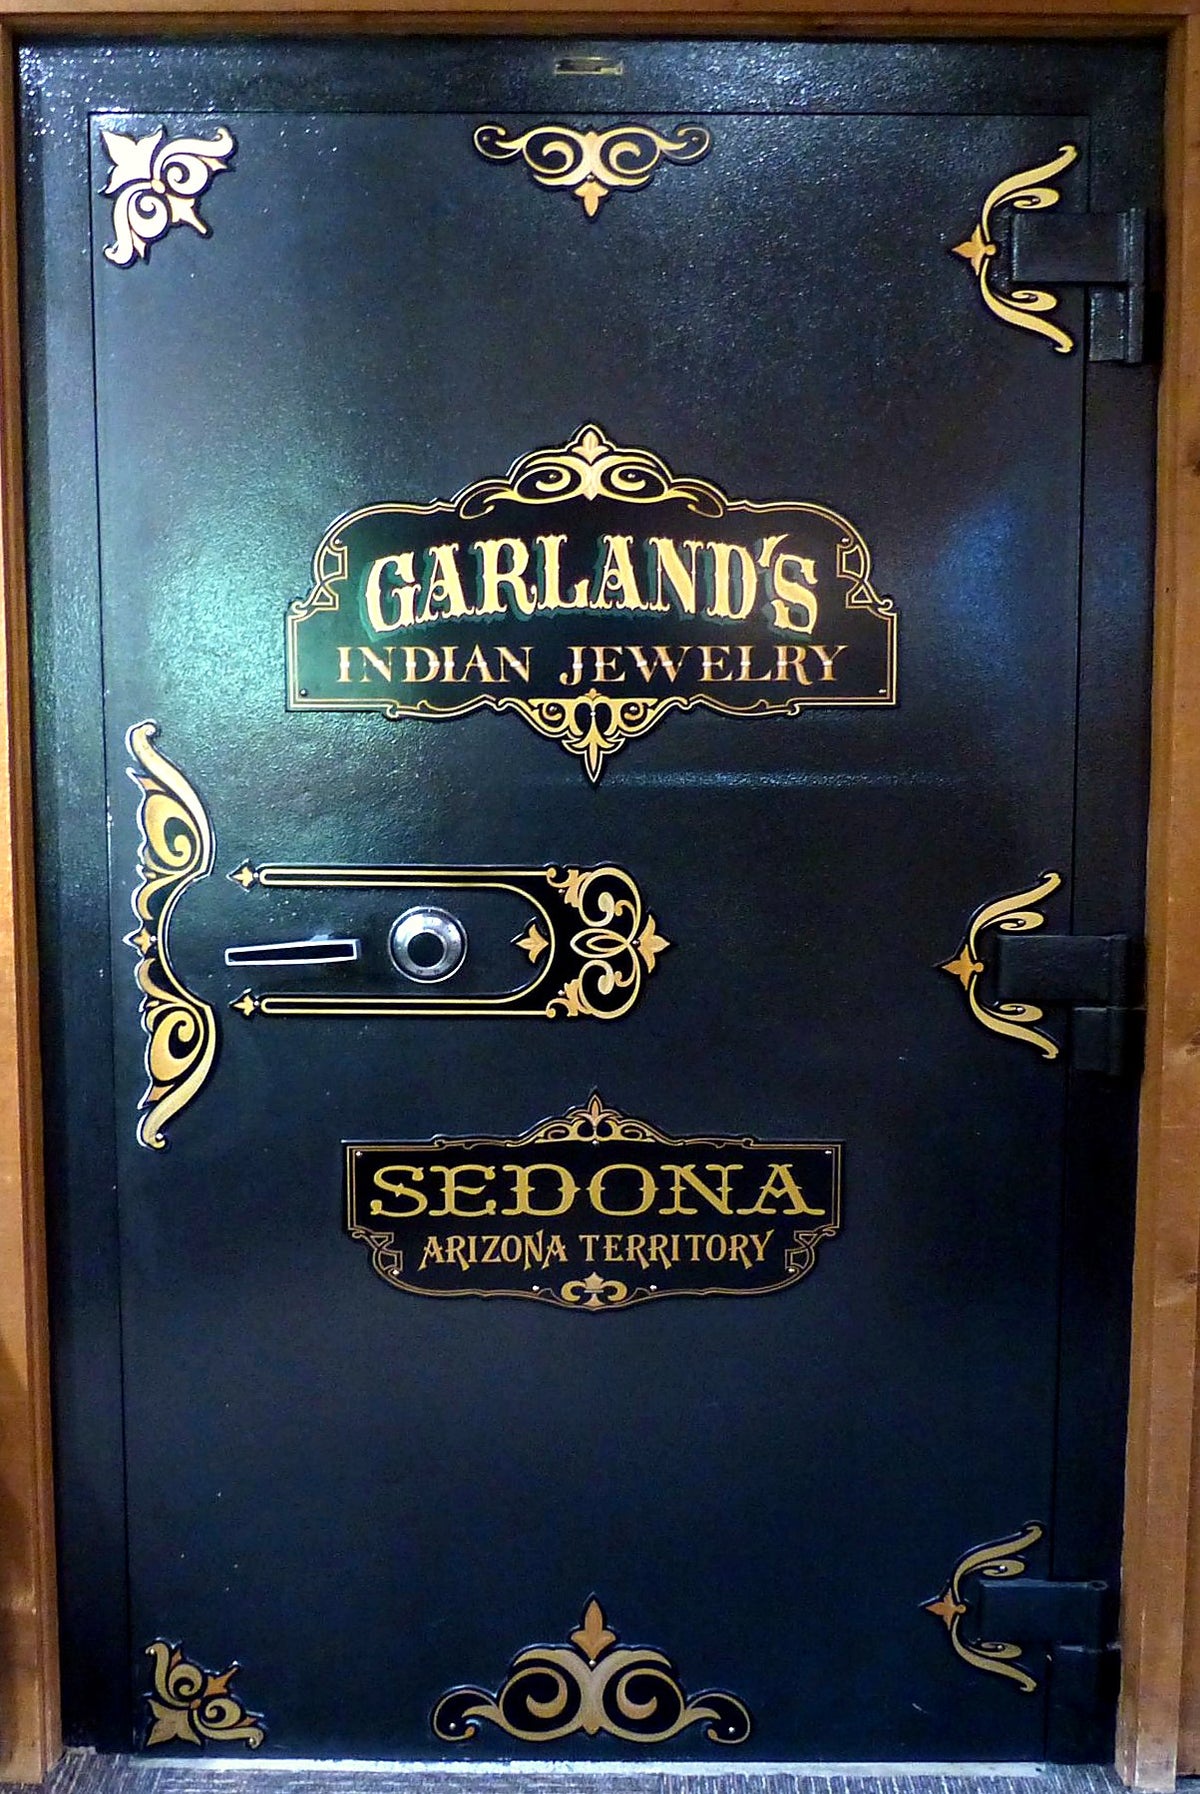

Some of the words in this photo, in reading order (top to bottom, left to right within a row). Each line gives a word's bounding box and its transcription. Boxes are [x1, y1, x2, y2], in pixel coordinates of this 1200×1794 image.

[364, 533, 818, 634] GARLAND'S
[336, 645, 534, 684] INDIAN
[559, 644, 848, 686] JEWELRY
[370, 1163, 826, 1217] SEDONA
[418, 1229, 568, 1271] ARIZONA
[579, 1229, 774, 1270] TERRITORY
